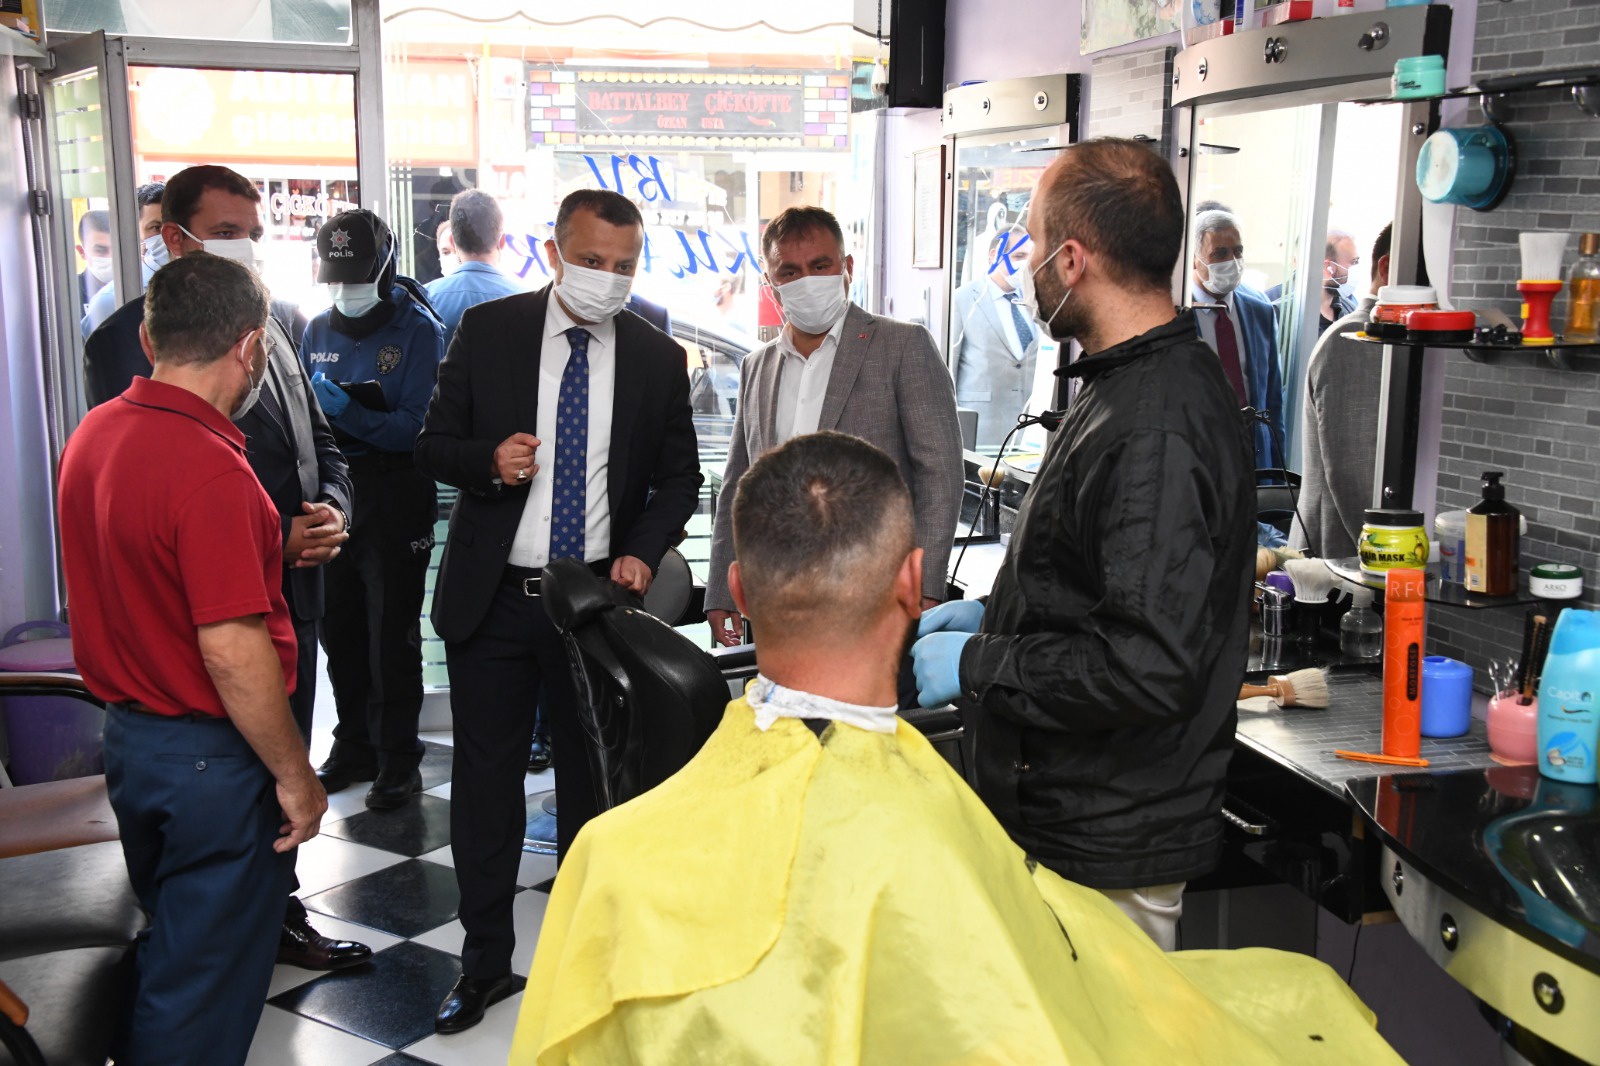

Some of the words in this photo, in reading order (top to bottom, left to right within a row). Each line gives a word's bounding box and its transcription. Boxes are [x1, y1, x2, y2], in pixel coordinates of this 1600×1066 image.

[588, 91, 691, 111] BATTALBEY
[704, 90, 792, 115] ÇİĞKÖFTE
[701, 117, 724, 129] USTA
[329, 249, 354, 258] POLİS
[1379, 553, 1405, 562] MASK
